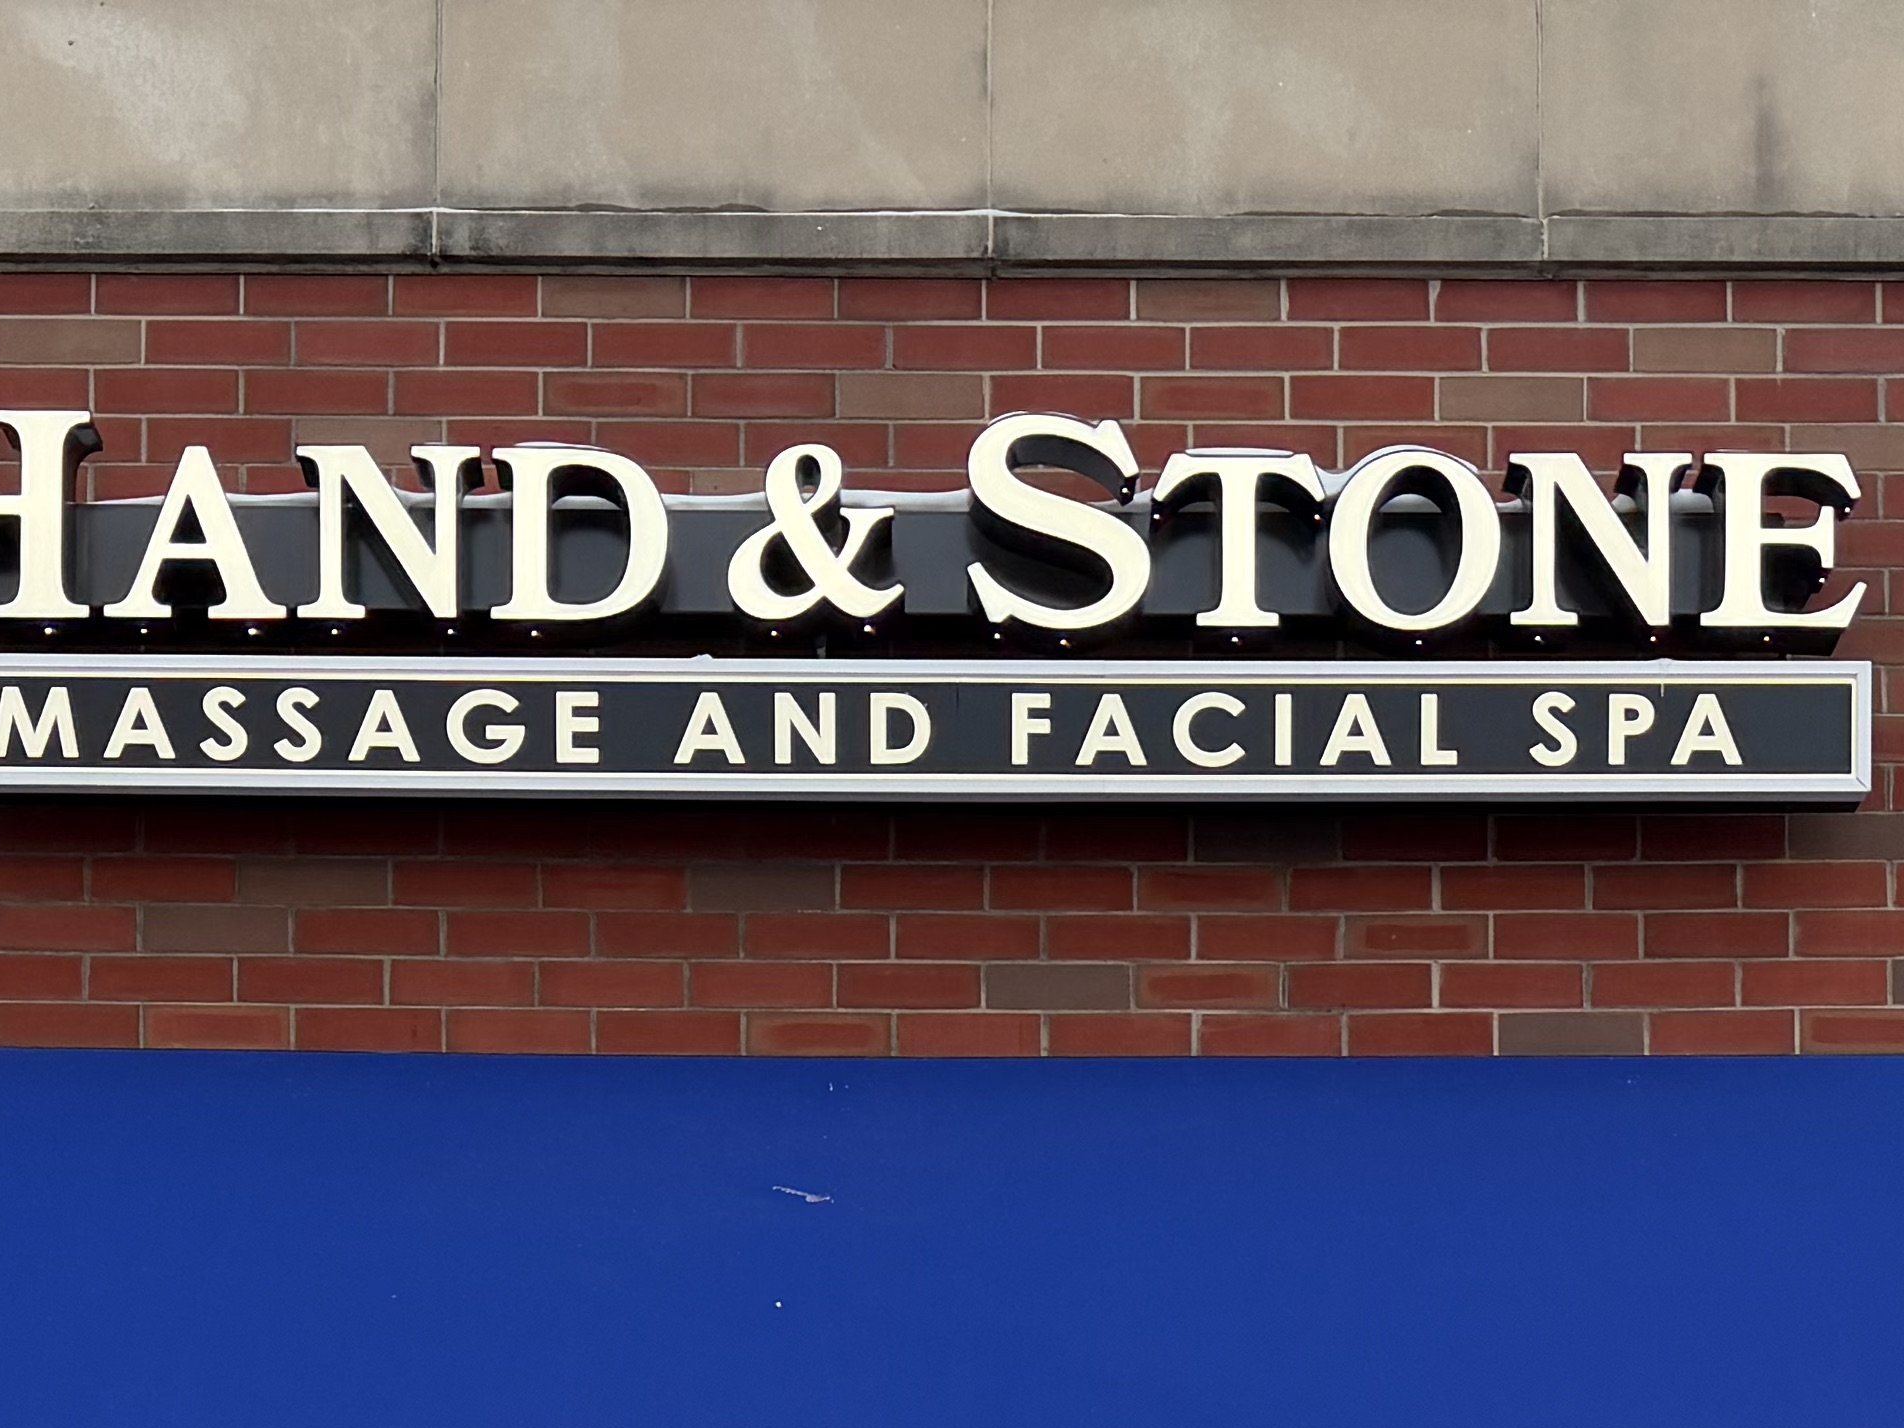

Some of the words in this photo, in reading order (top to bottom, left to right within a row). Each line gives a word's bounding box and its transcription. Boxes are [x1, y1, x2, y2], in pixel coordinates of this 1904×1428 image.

[727, 443, 905, 622] &
[966, 412, 1868, 631] STONE
[673, 690, 932, 767] AND
[1011, 691, 1459, 768] FACIAL
[1528, 691, 1744, 768] SPA
